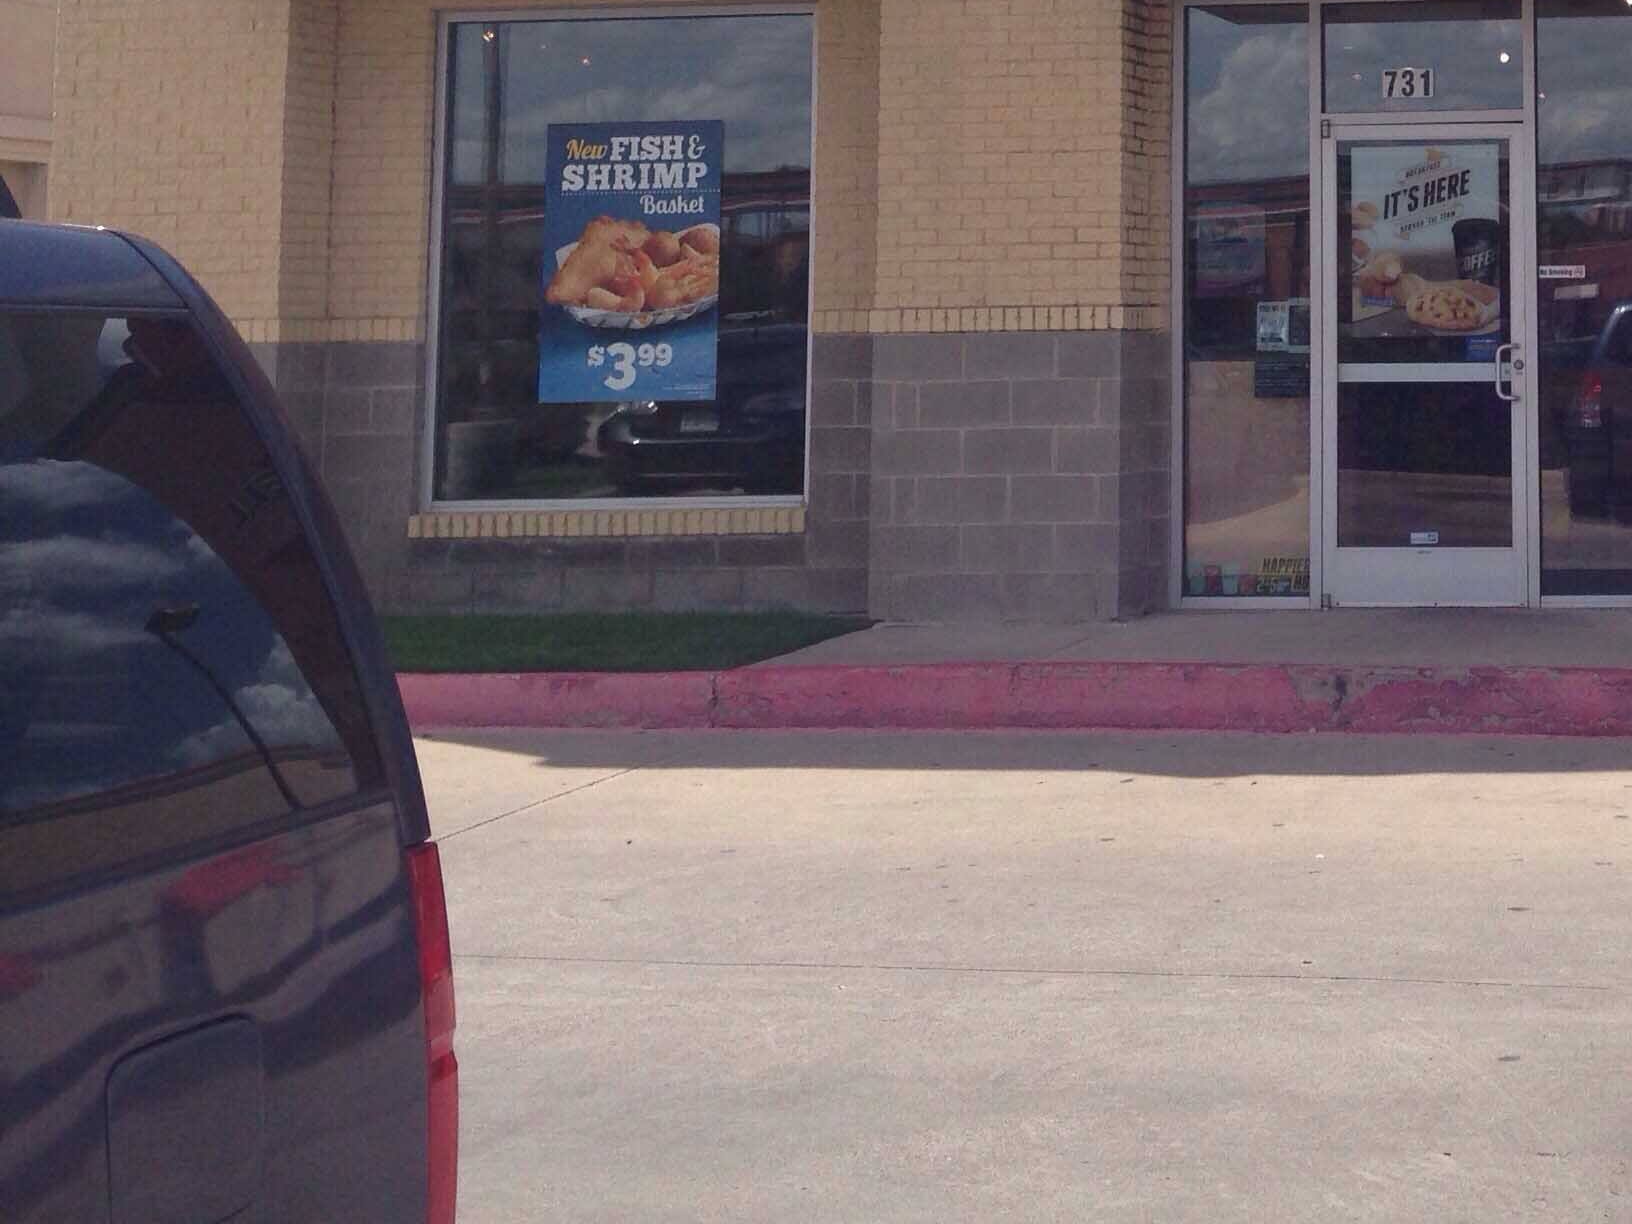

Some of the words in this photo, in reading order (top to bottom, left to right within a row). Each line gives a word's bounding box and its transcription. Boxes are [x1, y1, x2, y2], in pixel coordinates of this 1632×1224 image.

[1384, 69, 1431, 97] 731
[566, 138, 608, 160] New
[609, 135, 684, 161] FISH
[687, 134, 707, 160] &
[561, 161, 709, 192] SHRIMP
[639, 194, 705, 215] Basket
[1383, 185, 1420, 221] IT'S
[1423, 169, 1471, 208] HERE
